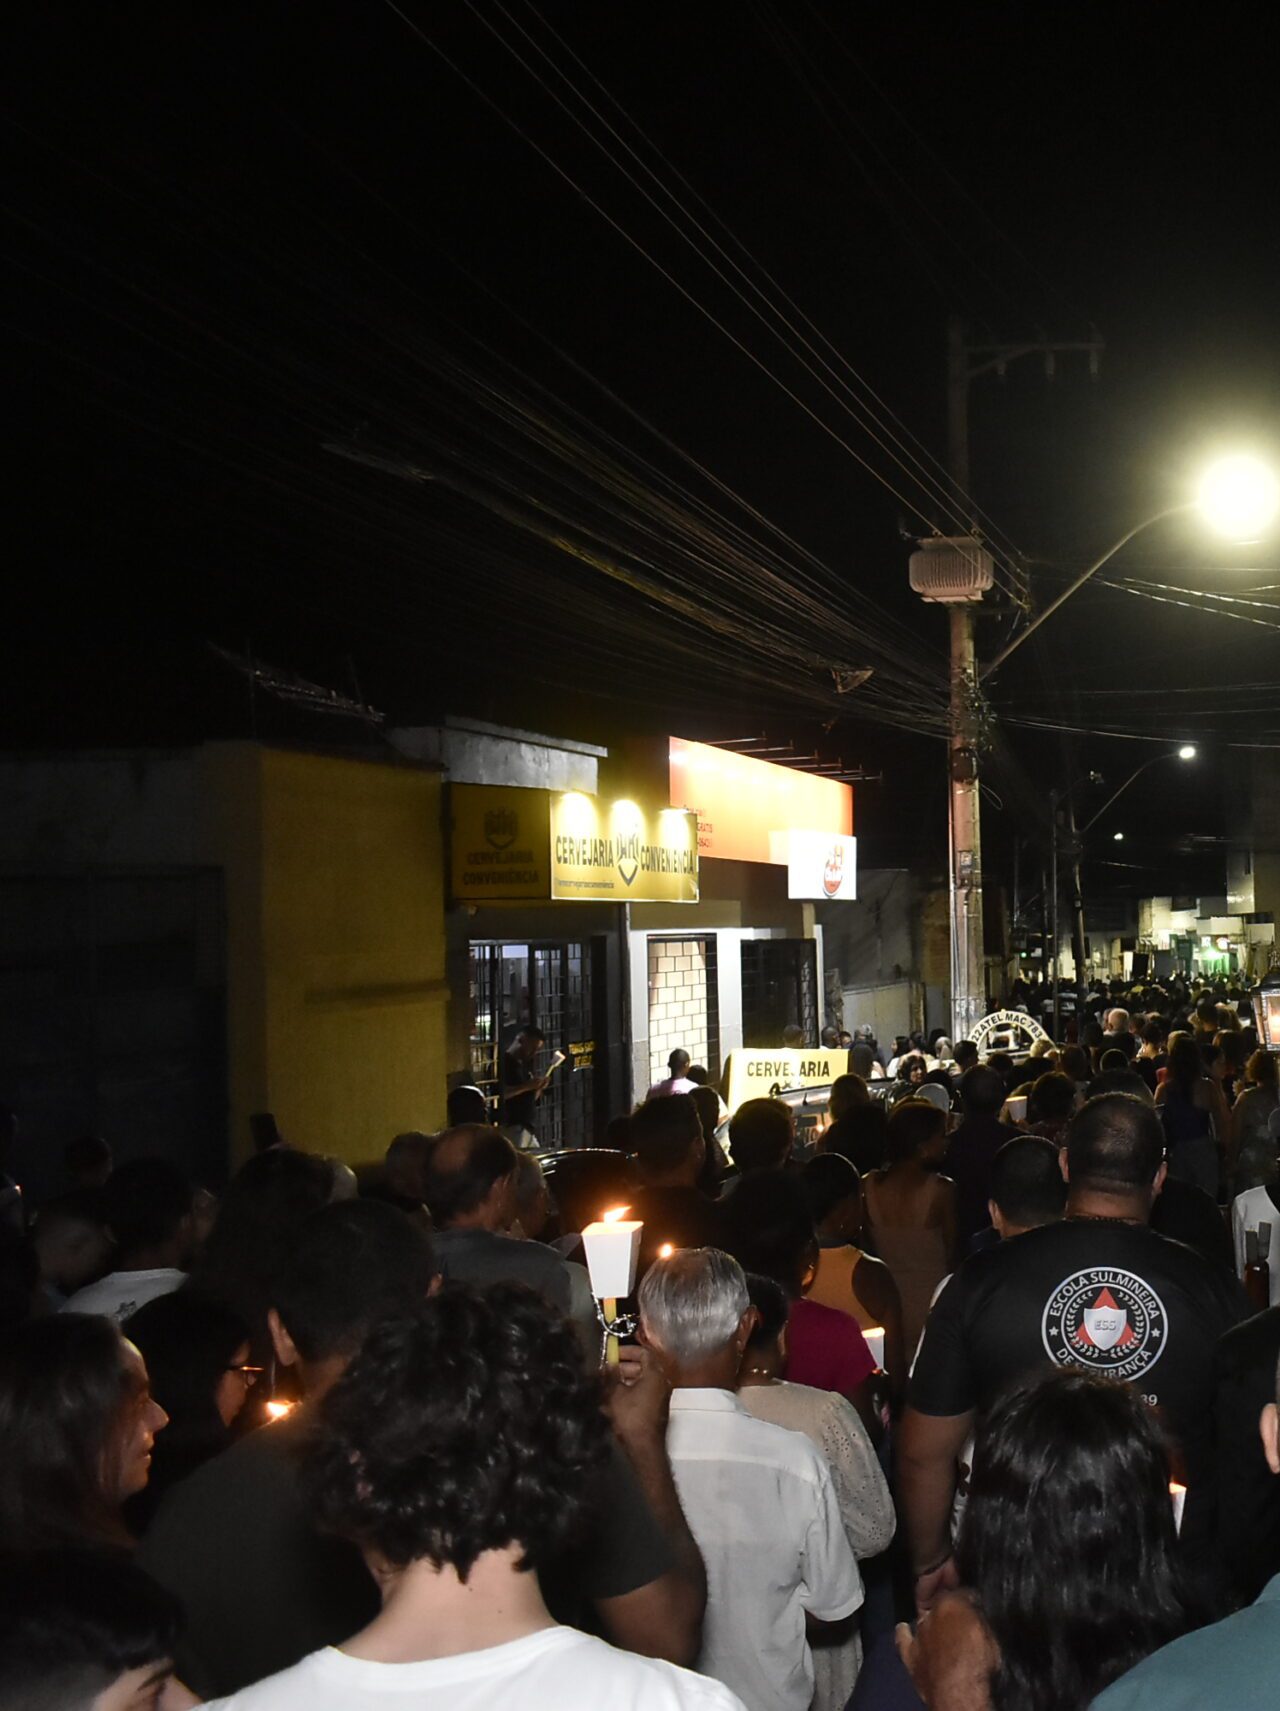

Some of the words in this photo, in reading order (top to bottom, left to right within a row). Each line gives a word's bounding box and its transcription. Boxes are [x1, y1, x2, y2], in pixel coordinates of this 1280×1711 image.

[555, 835, 615, 868] CERVEJARIA
[747, 1060, 830, 1077] CERVEARIA
[1049, 1275, 1090, 1317] ESCOLA
[1090, 1271, 1161, 1320] SULMINEIRA
[1056, 1347, 1075, 1366] DE
